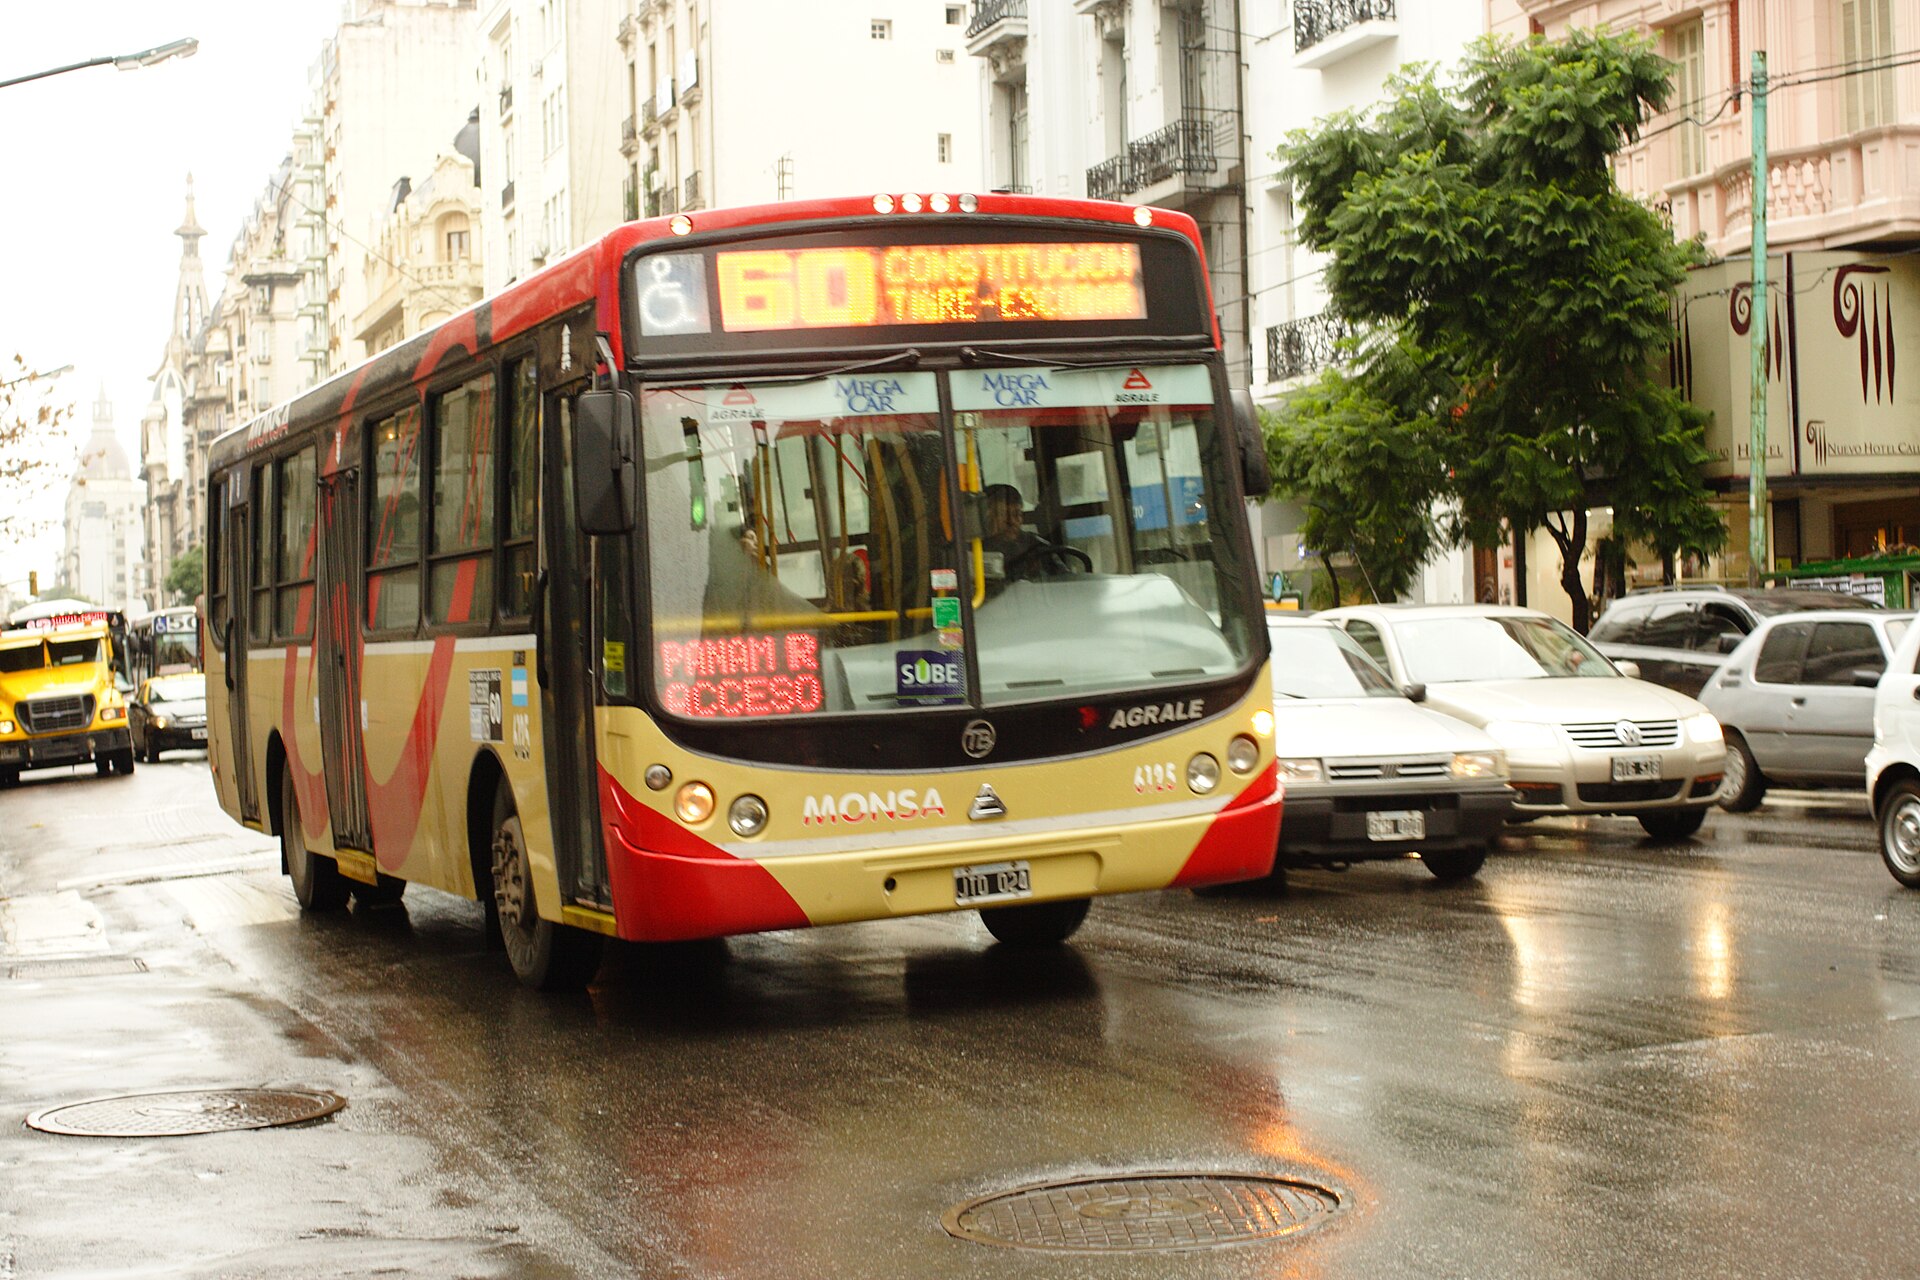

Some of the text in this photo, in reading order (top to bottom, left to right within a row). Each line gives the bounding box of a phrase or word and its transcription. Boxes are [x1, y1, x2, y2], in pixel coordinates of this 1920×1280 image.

[884, 246, 1132, 283] CONSTITUCION
[717, 251, 876, 327] 60
[835, 377, 908, 397] MEGA
[981, 373, 1050, 391] MEGA
[849, 395, 897, 413] CAR
[995, 389, 1042, 406] CAR
[1115, 393, 1160, 404] AGRALE
[711, 408, 766, 421] AGRALE
[660, 635, 776, 677] PANAM
[785, 633, 819, 671] R
[900, 658, 960, 685] SUBE
[664, 674, 823, 718] ACCESO
[1108, 699, 1206, 730] AGRALE
[803, 787, 945, 827] MONSA
